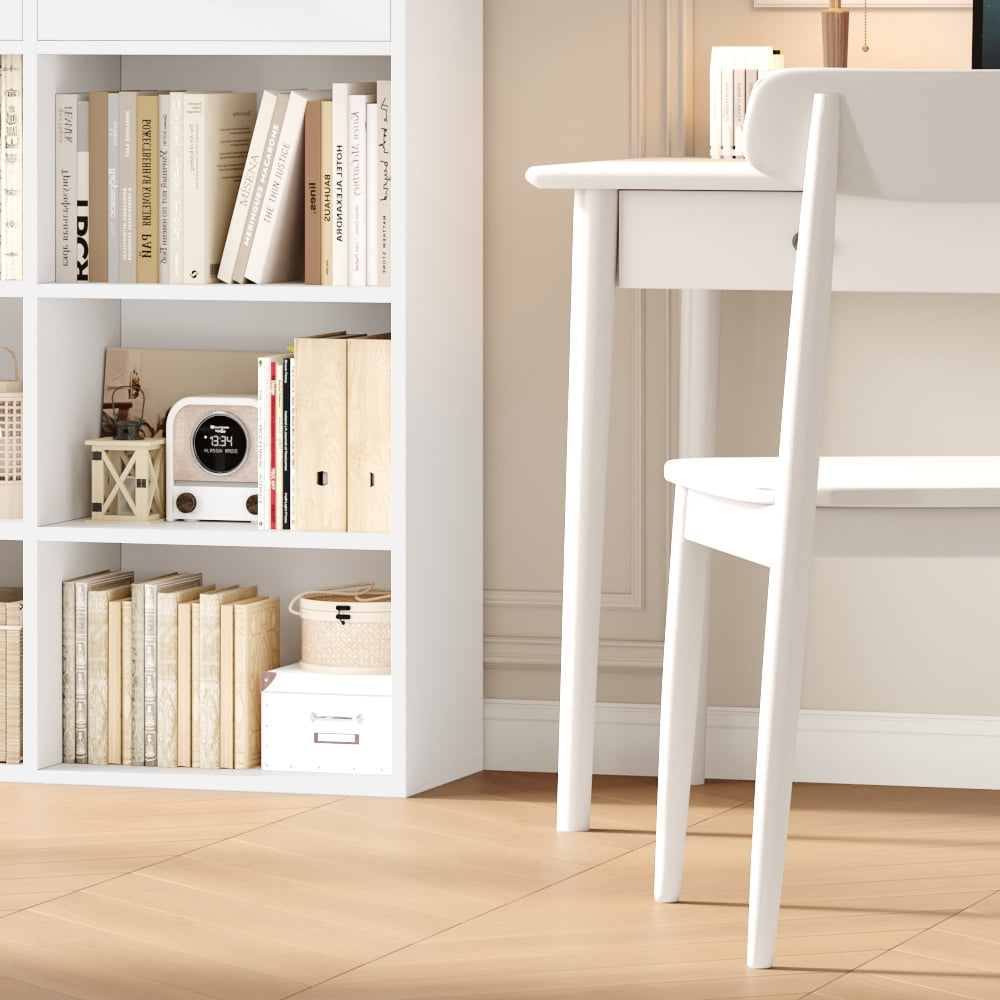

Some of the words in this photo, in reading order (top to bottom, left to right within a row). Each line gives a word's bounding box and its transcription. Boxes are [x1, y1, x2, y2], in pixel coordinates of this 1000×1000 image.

[239, 155, 260, 207] MISENA
[274, 142, 291, 181] JUSTICE
[243, 185, 264, 247] MERINGUES
[259, 124, 279, 185] MACARONS
[268, 181, 280, 204] THIN
[263, 205, 274, 224] THE
